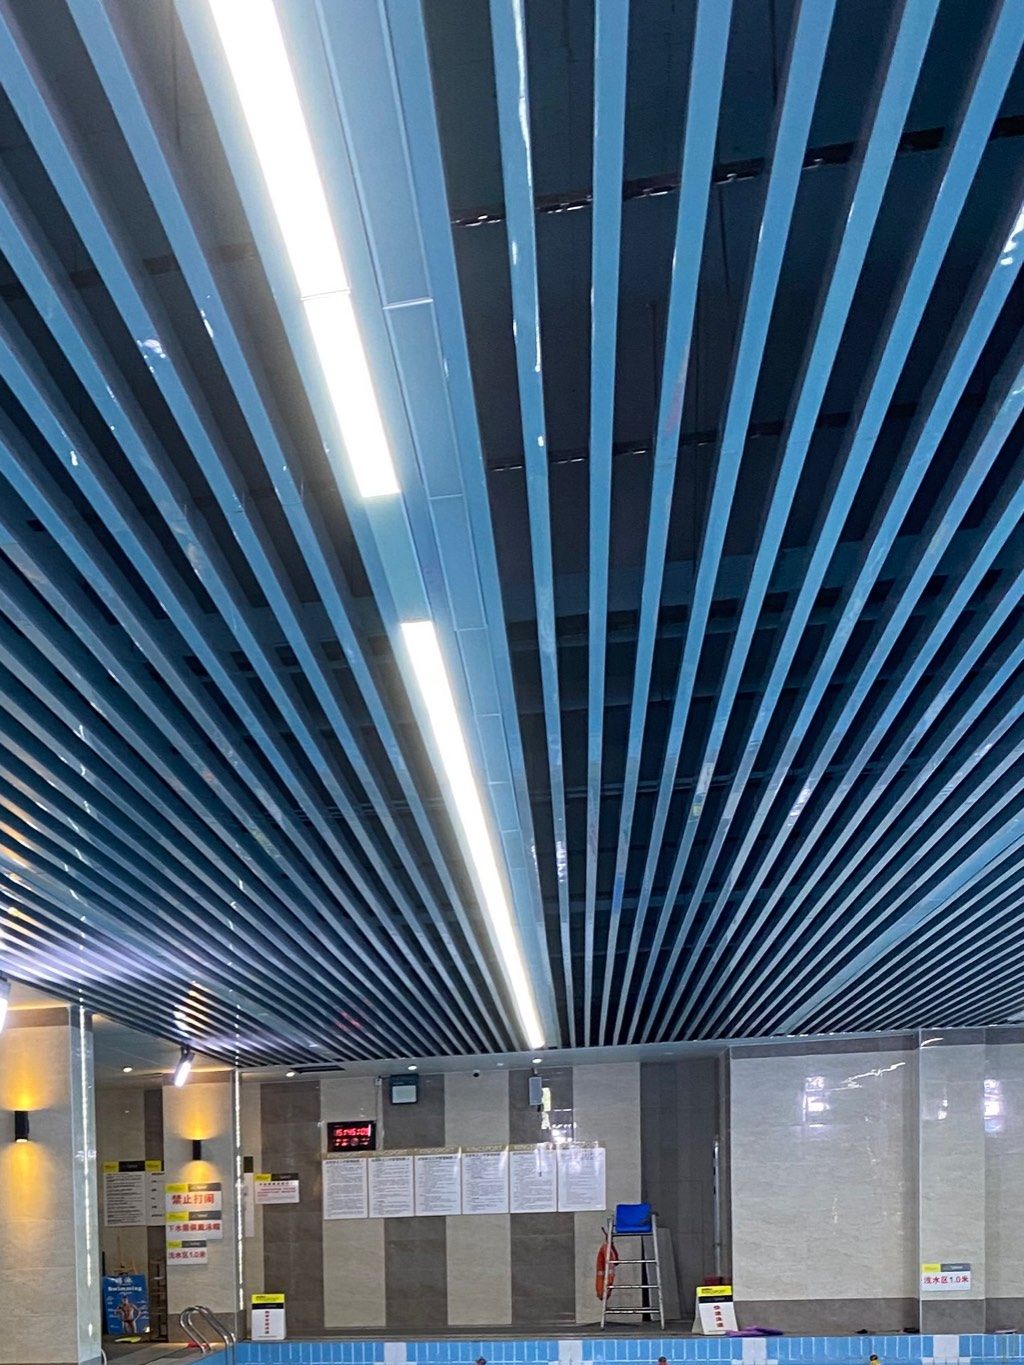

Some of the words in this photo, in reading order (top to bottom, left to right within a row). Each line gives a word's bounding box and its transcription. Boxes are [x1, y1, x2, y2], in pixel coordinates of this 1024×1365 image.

[172, 1193, 215, 1205] 禁止打闹
[923, 1275, 969, 1285] 浅水区1.0米
